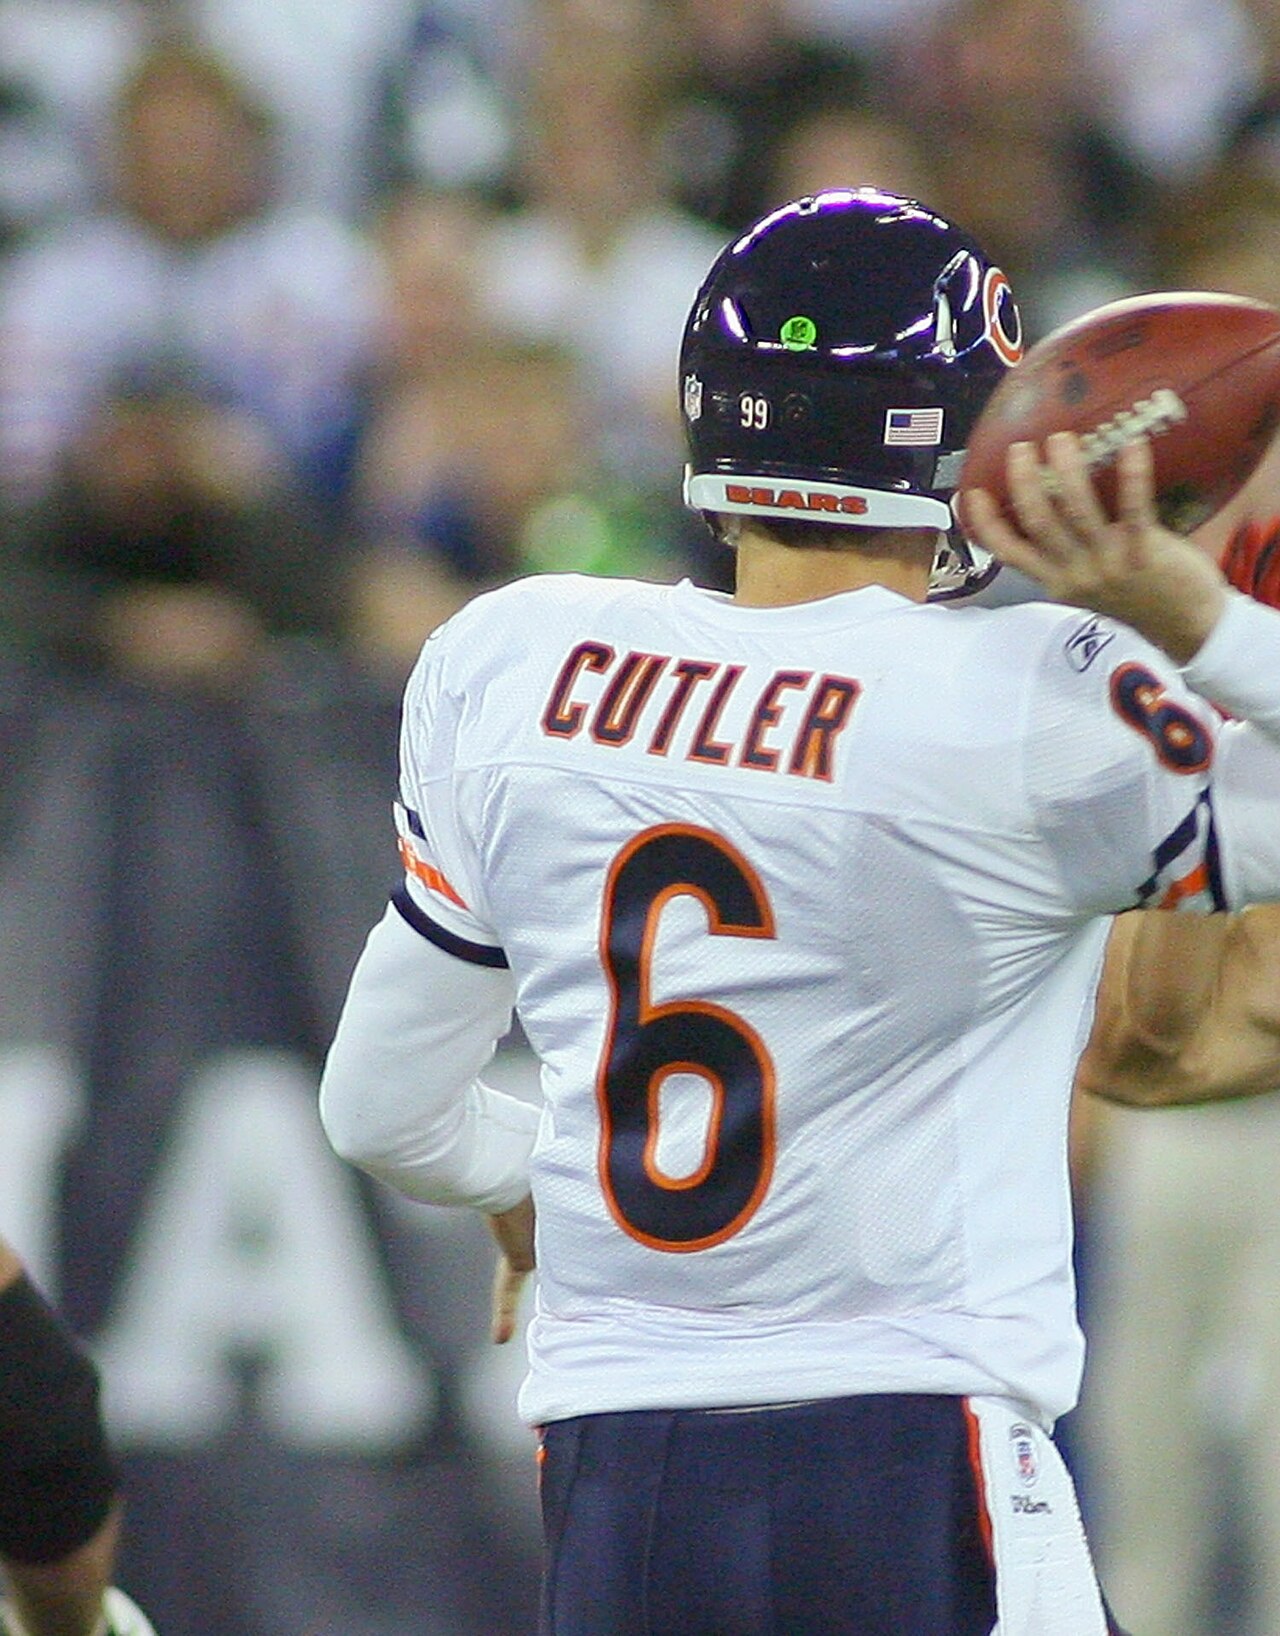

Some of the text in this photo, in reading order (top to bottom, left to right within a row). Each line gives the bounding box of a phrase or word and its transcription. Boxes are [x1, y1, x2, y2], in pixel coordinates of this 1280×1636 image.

[740, 396, 768, 430] 99
[725, 484, 869, 515] BEARS
[540, 640, 864, 783] CUTLER
[1109, 661, 1215, 776] 6
[597, 821, 778, 1254] 6
